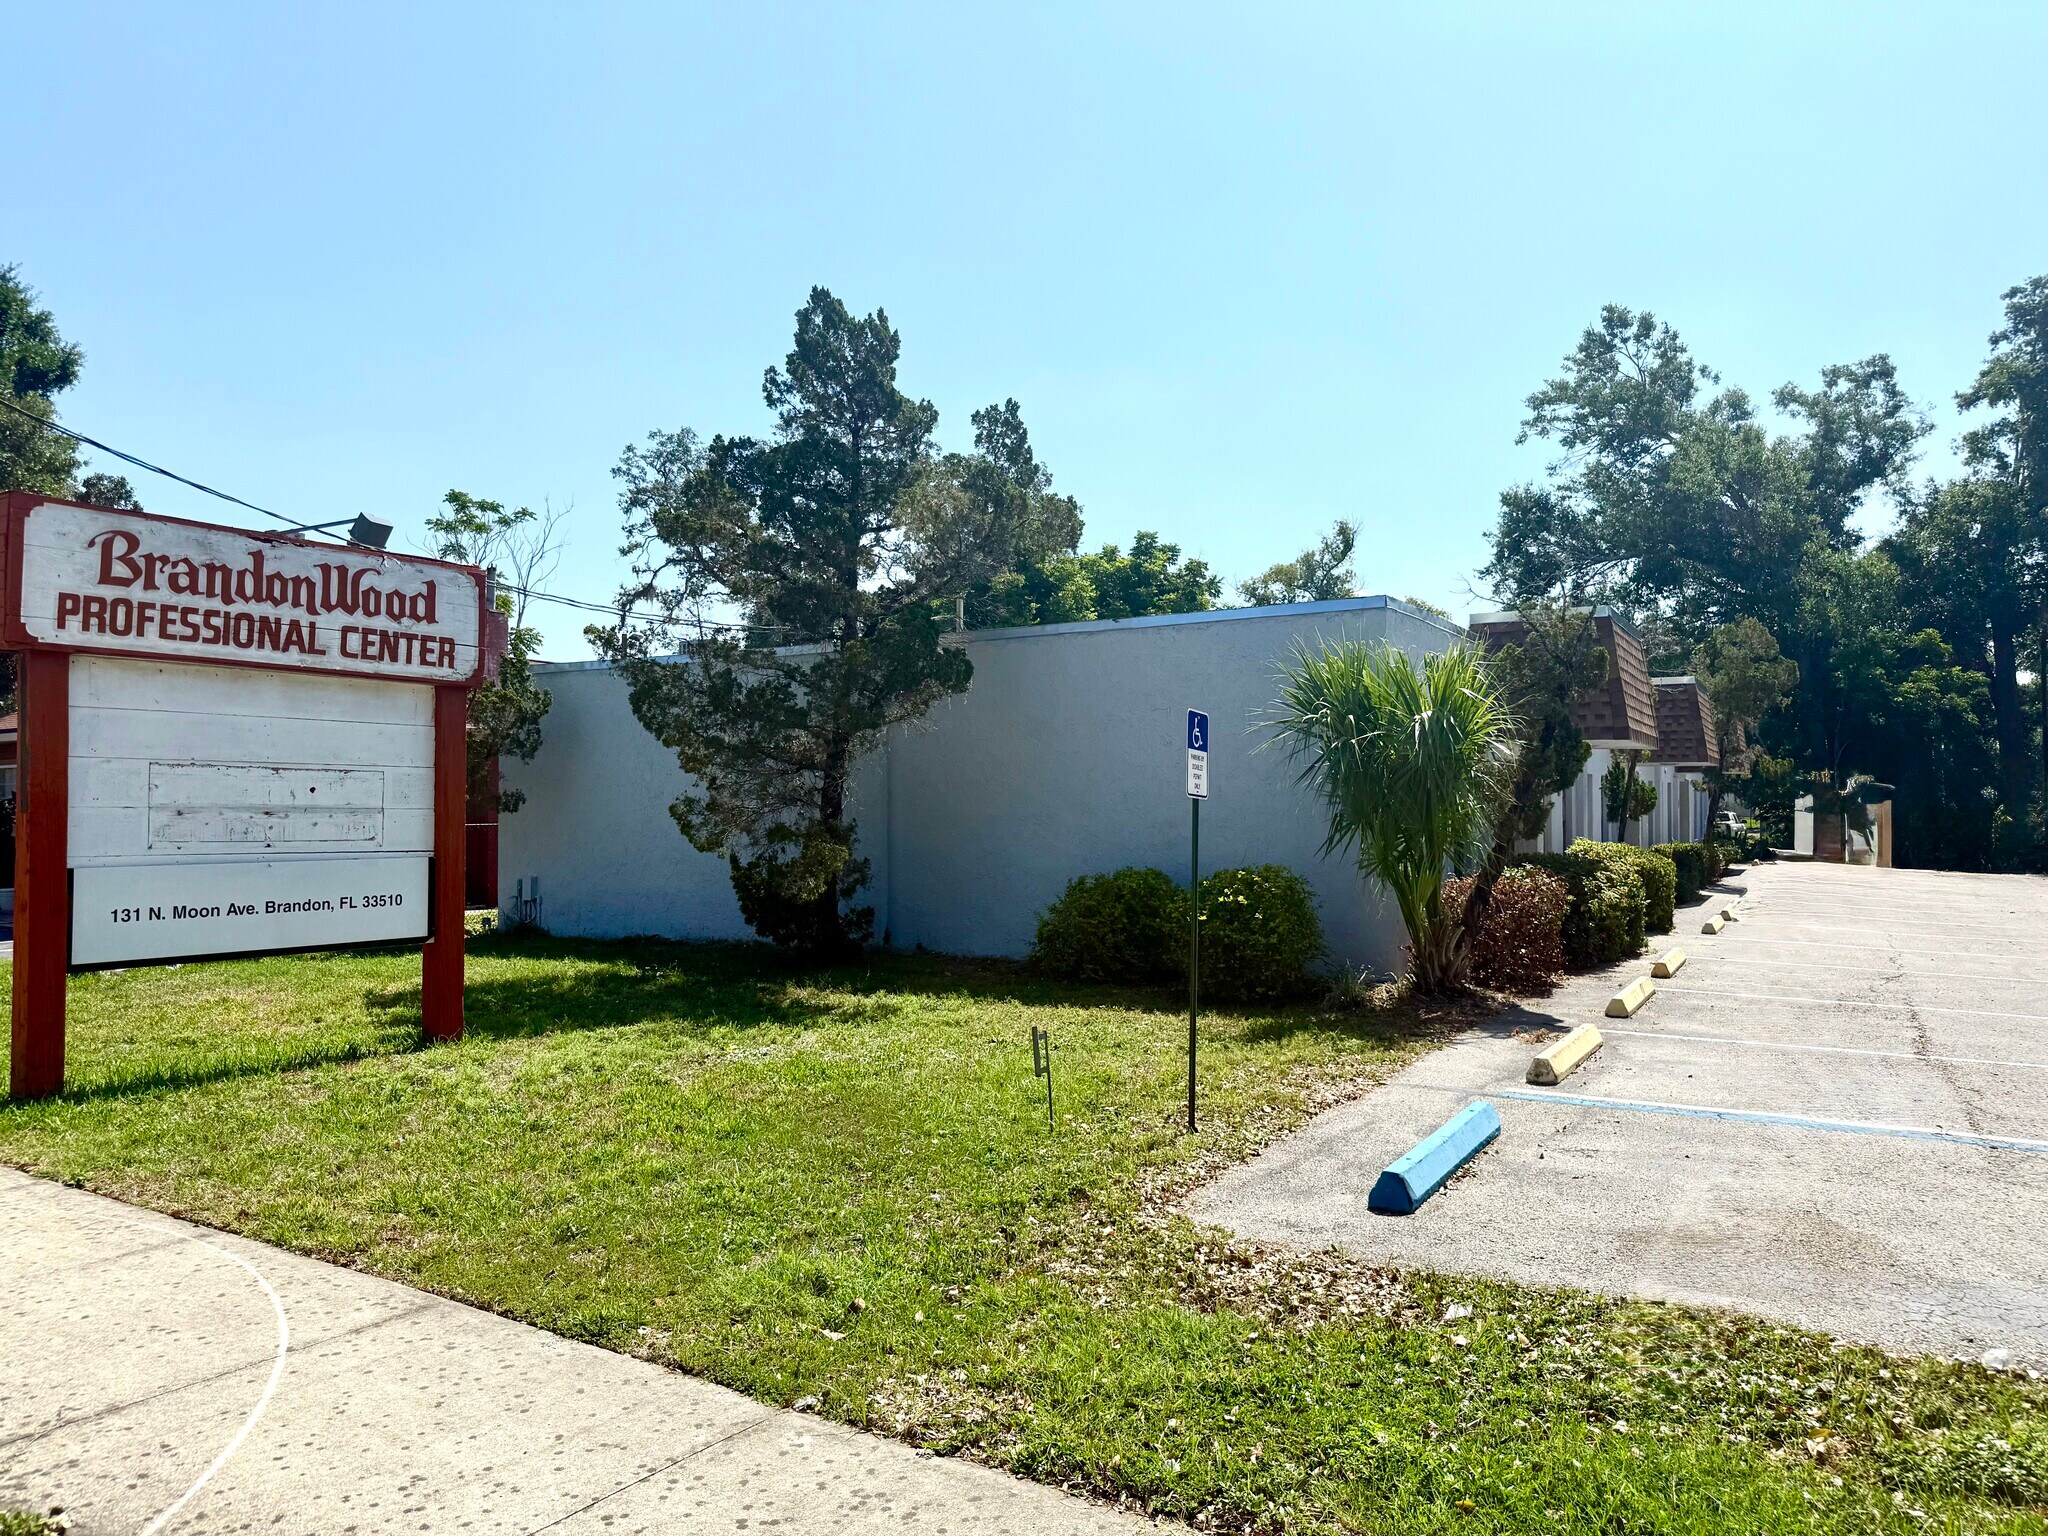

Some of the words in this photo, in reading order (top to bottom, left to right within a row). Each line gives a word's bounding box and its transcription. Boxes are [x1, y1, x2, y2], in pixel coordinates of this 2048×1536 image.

[88, 530, 439, 625] BrandonWood
[56, 592, 327, 656] PROFESSIONAL
[339, 626, 456, 669] CENTER
[111, 907, 141, 923] 131
[149, 906, 166, 921] N.
[172, 905, 221, 920] Moon
[226, 902, 259, 917] Ave.
[265, 898, 335, 914] Brandon,
[339, 896, 358, 909] FL
[362, 893, 403, 908] 33510
